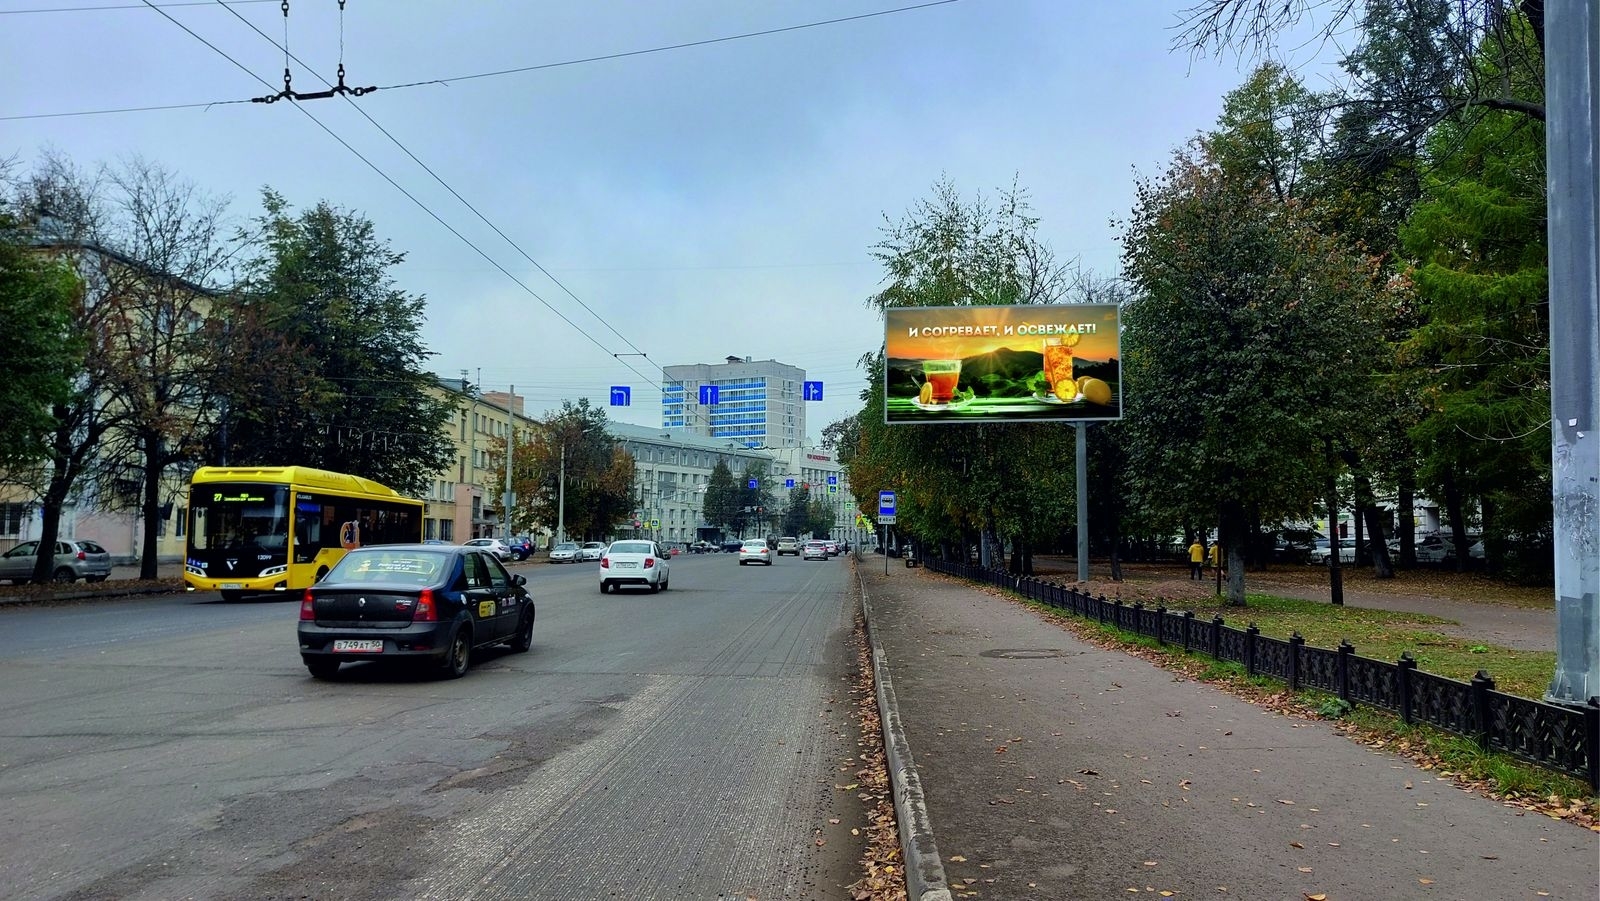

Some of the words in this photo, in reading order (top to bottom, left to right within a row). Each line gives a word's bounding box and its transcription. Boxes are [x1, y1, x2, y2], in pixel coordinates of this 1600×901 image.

[908, 327, 919, 337] И
[922, 325, 1000, 337] СОГРЕВАЕТ,
[1003, 325, 1014, 335] И
[1017, 323, 1096, 336] ОСВЕЖАЕТ!
[213, 493, 222, 501] 27
